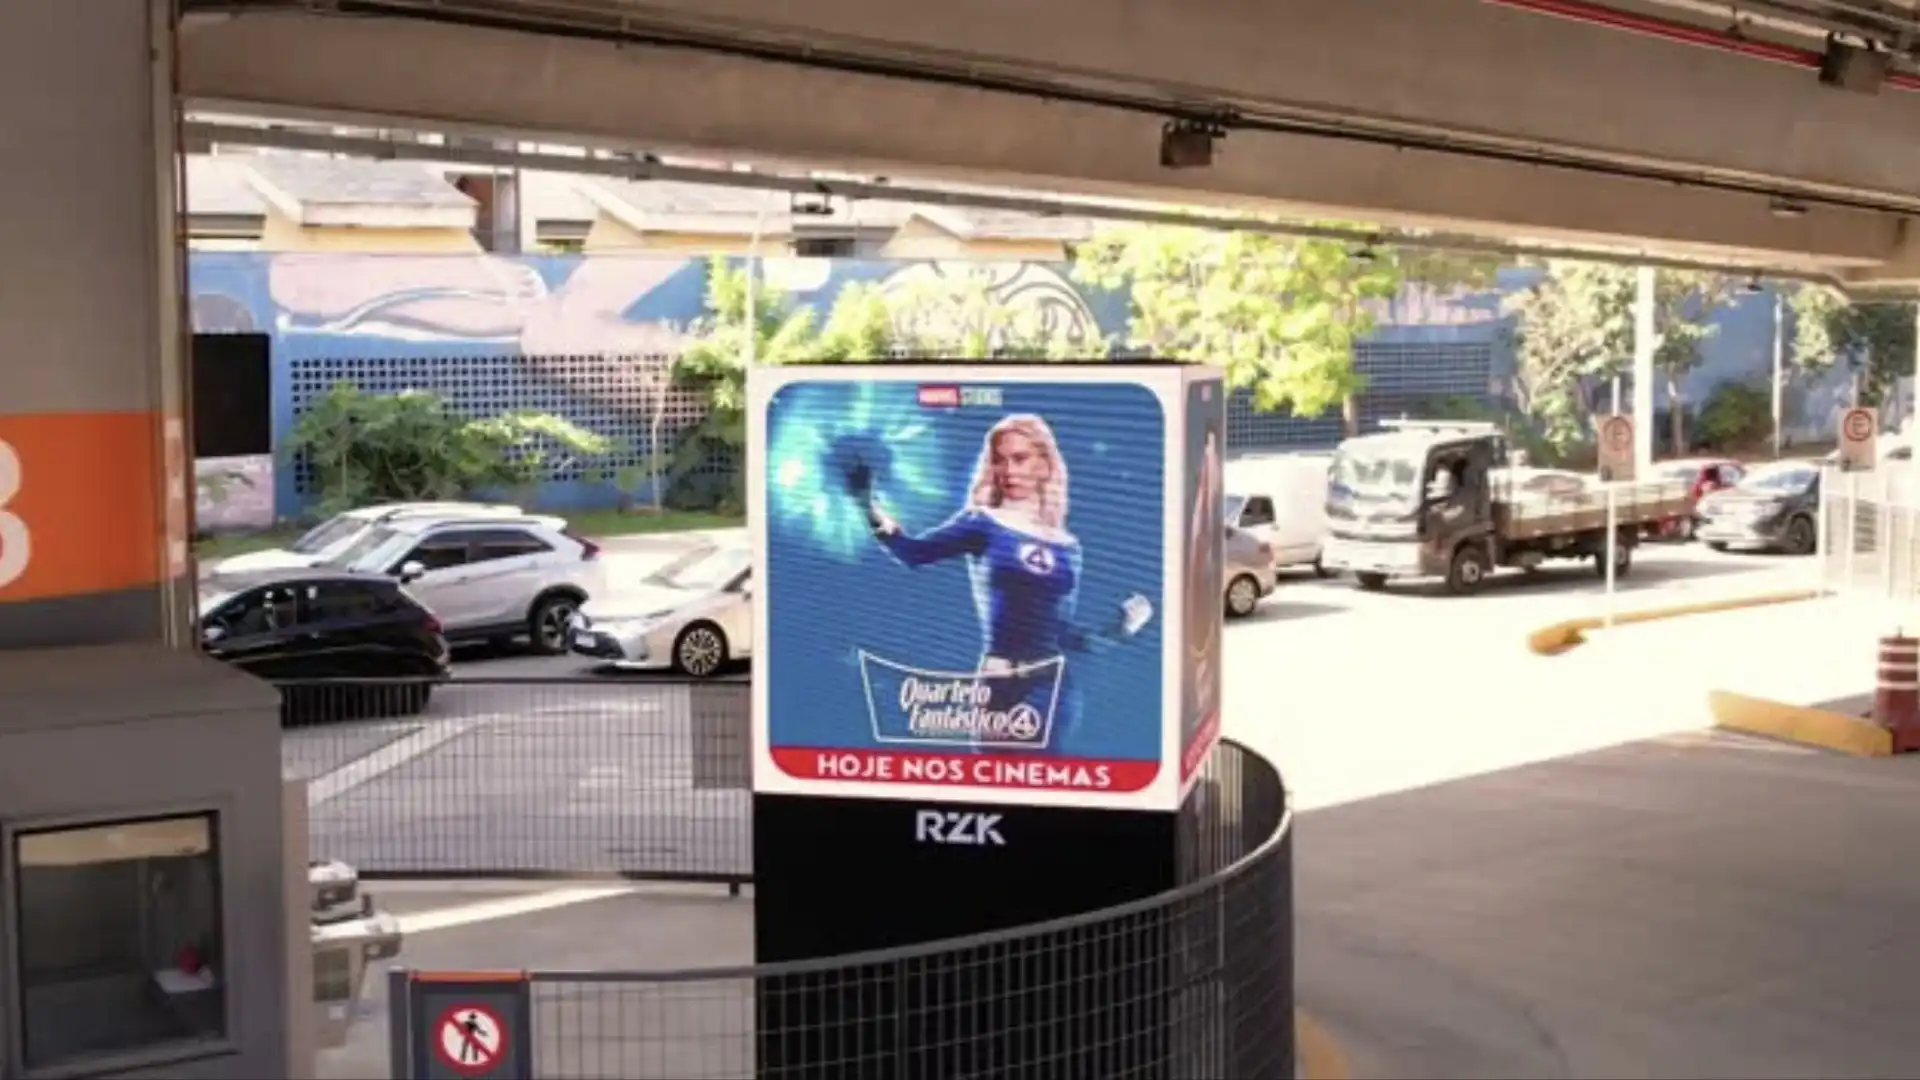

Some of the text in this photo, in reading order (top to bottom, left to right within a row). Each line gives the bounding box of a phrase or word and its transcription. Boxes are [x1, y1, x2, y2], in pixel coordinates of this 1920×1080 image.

[901, 678, 991, 711] Quarteto
[909, 702, 1009, 733] Fantástico
[817, 754, 1112, 787] HOJE NOS CINEMAS
[916, 809, 1006, 845] RZK
